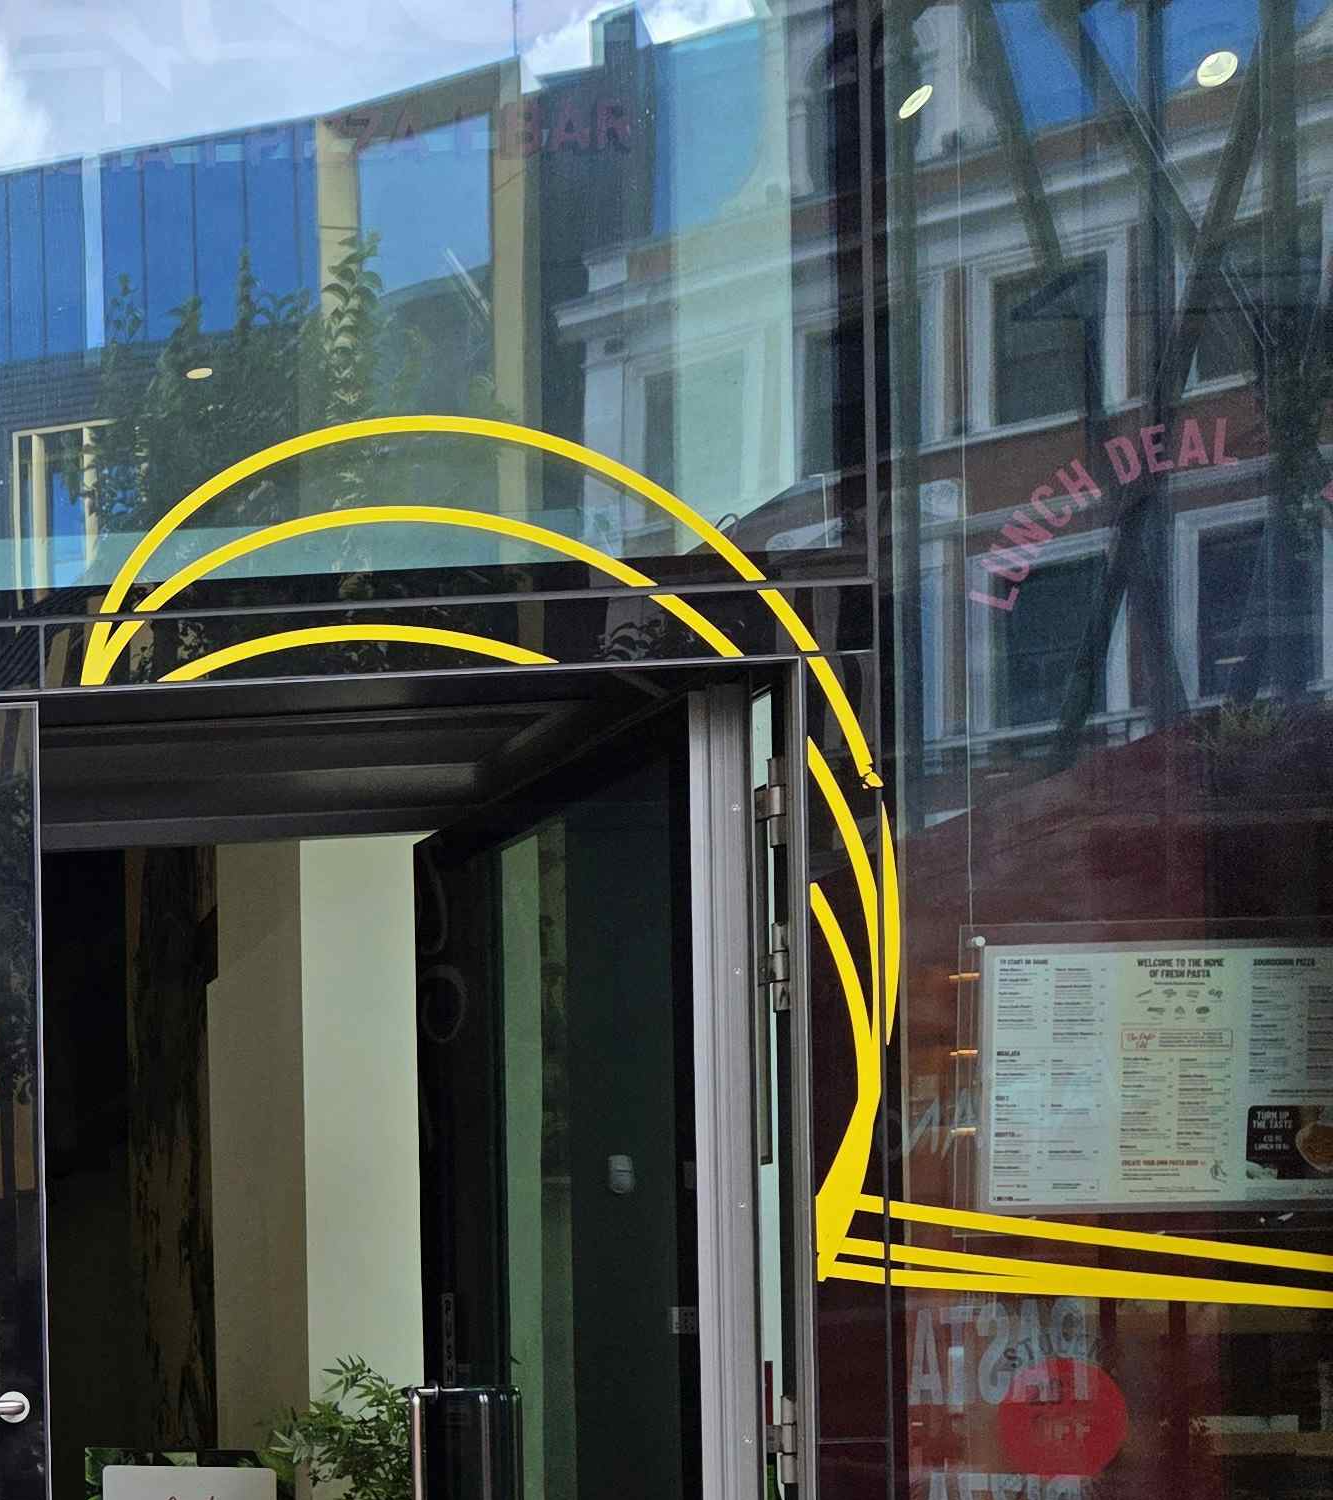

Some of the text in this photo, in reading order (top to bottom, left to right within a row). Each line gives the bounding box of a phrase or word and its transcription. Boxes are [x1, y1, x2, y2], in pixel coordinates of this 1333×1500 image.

[969, 416, 1239, 612] LUNCH DEAL
[1137, 958, 1224, 967] WELCOME TO THE HOME
[1149, 969, 1211, 978] OF FRESH PASTA
[443, 1299, 453, 1385] PUSH
